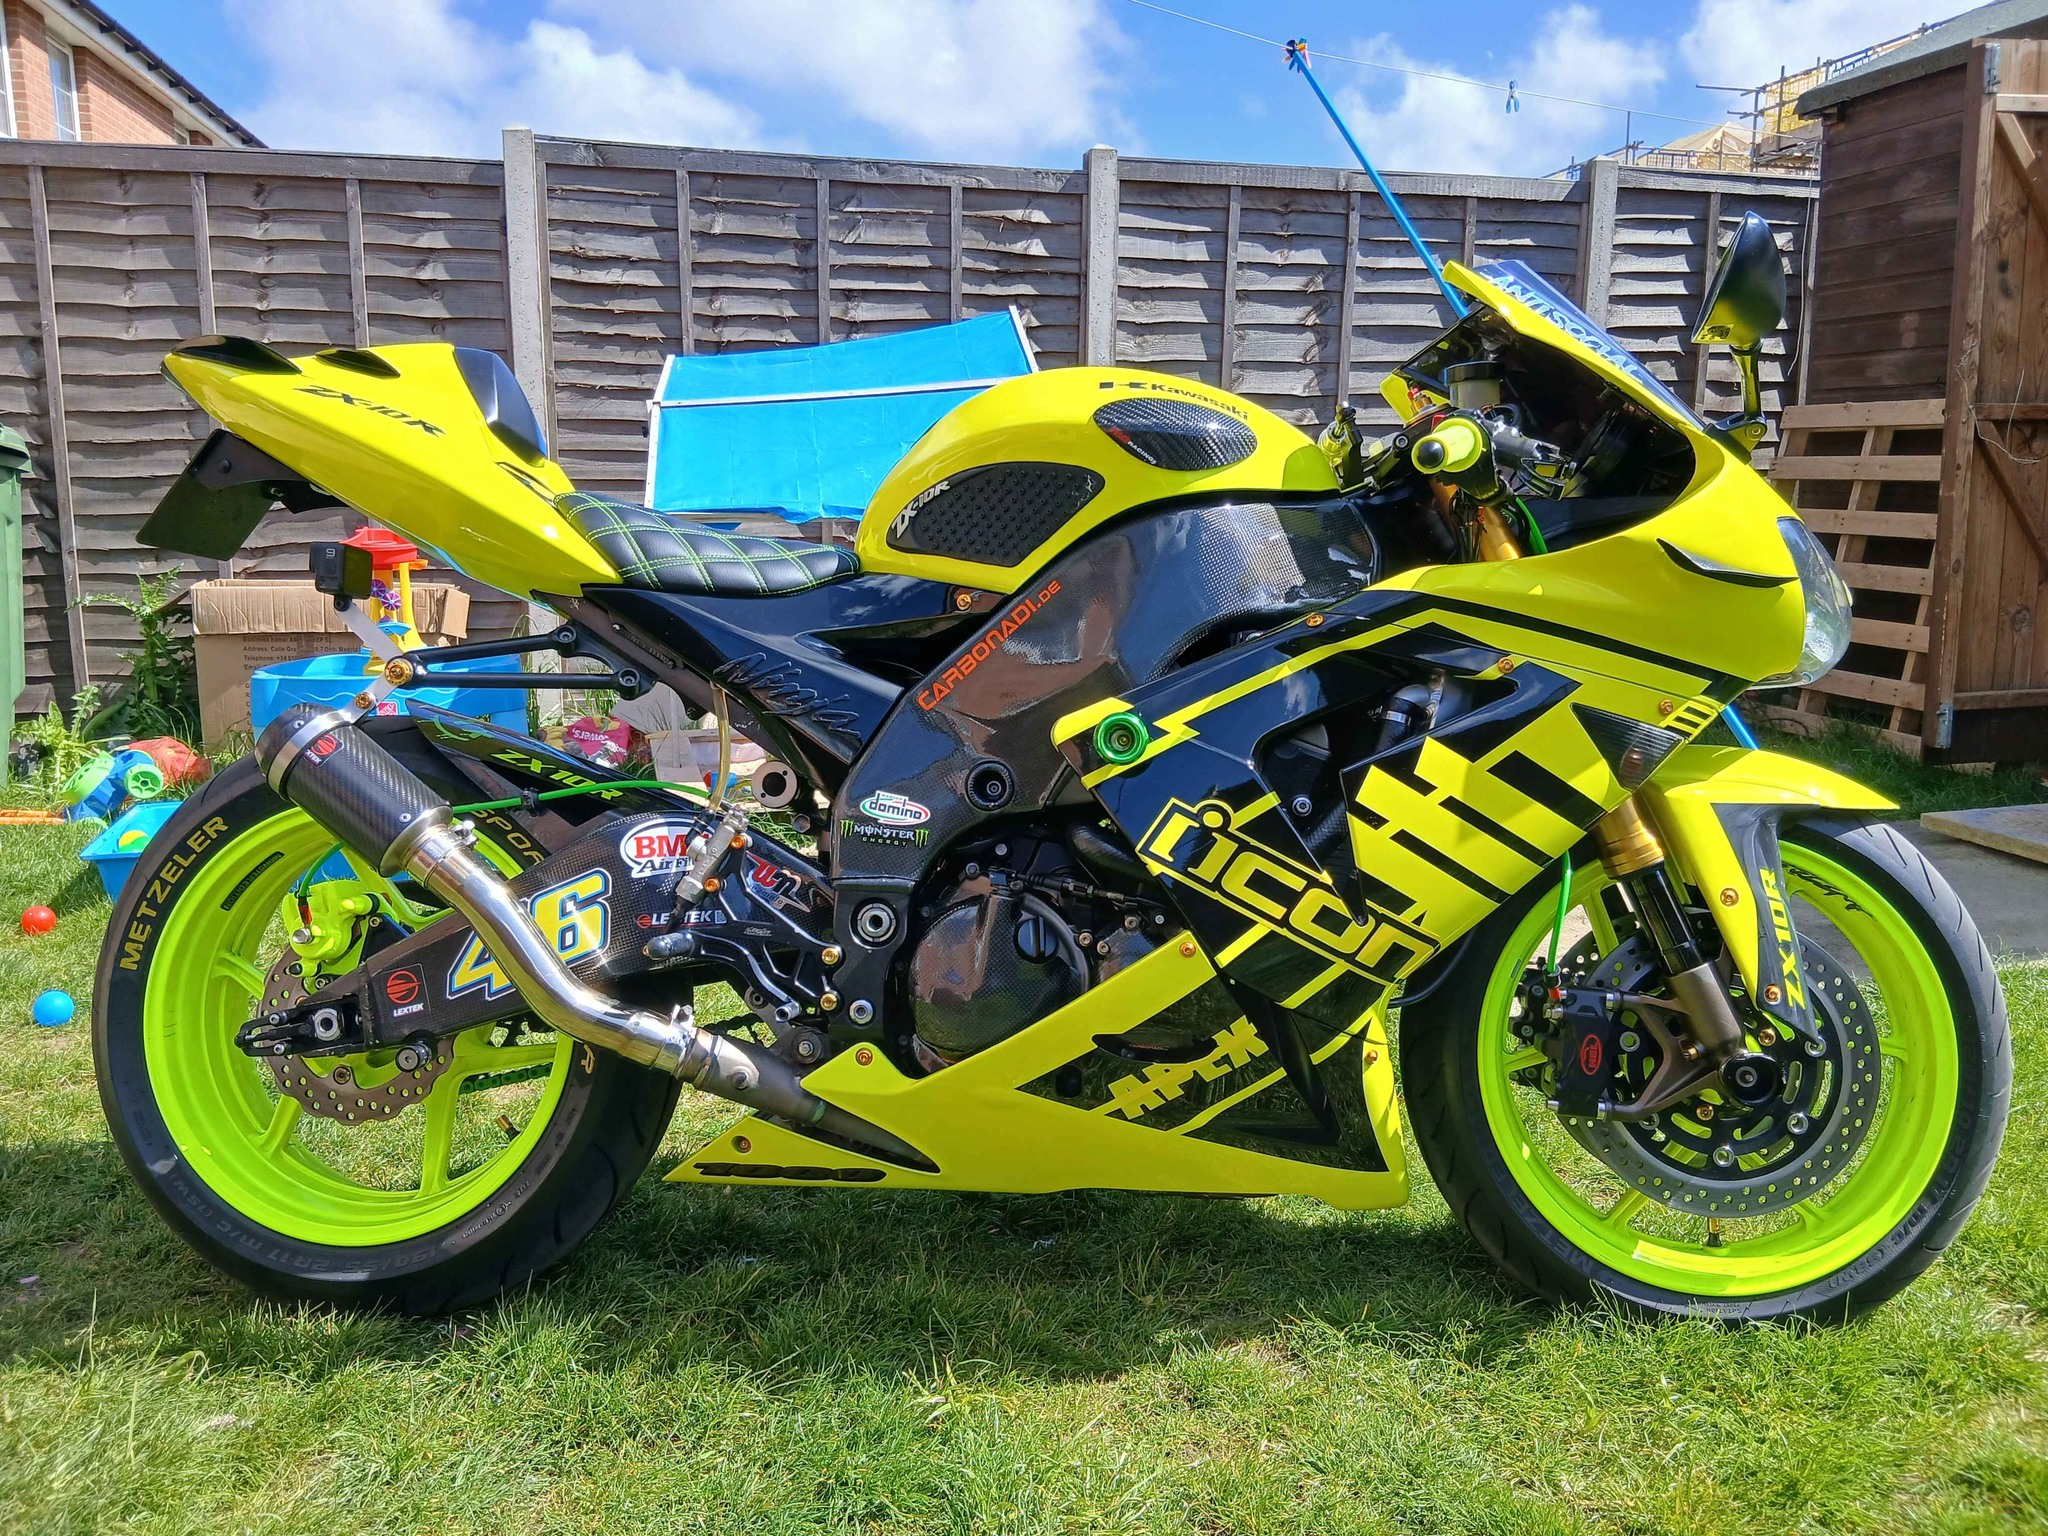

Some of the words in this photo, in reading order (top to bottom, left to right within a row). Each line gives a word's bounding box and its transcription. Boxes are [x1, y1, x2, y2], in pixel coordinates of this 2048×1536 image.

[1491, 275, 1643, 383] ANTISOCIAL
[1152, 383, 1248, 420] Kawasaki
[891, 480, 950, 539] ZX-10R
[916, 580, 1061, 711] CARBONADI.DE
[869, 793, 922, 819] domino
[634, 834, 709, 858] BM
[854, 823, 915, 841] MONSTER
[862, 836, 907, 847] ENERGY
[637, 859, 674, 874] Air
[120, 816, 229, 971] METZELER
[652, 909, 713, 926] LETEK
[447, 868, 612, 1001] 46
[1760, 868, 1806, 1010] ZX10R
[393, 1002, 424, 1018] LEXTEK
